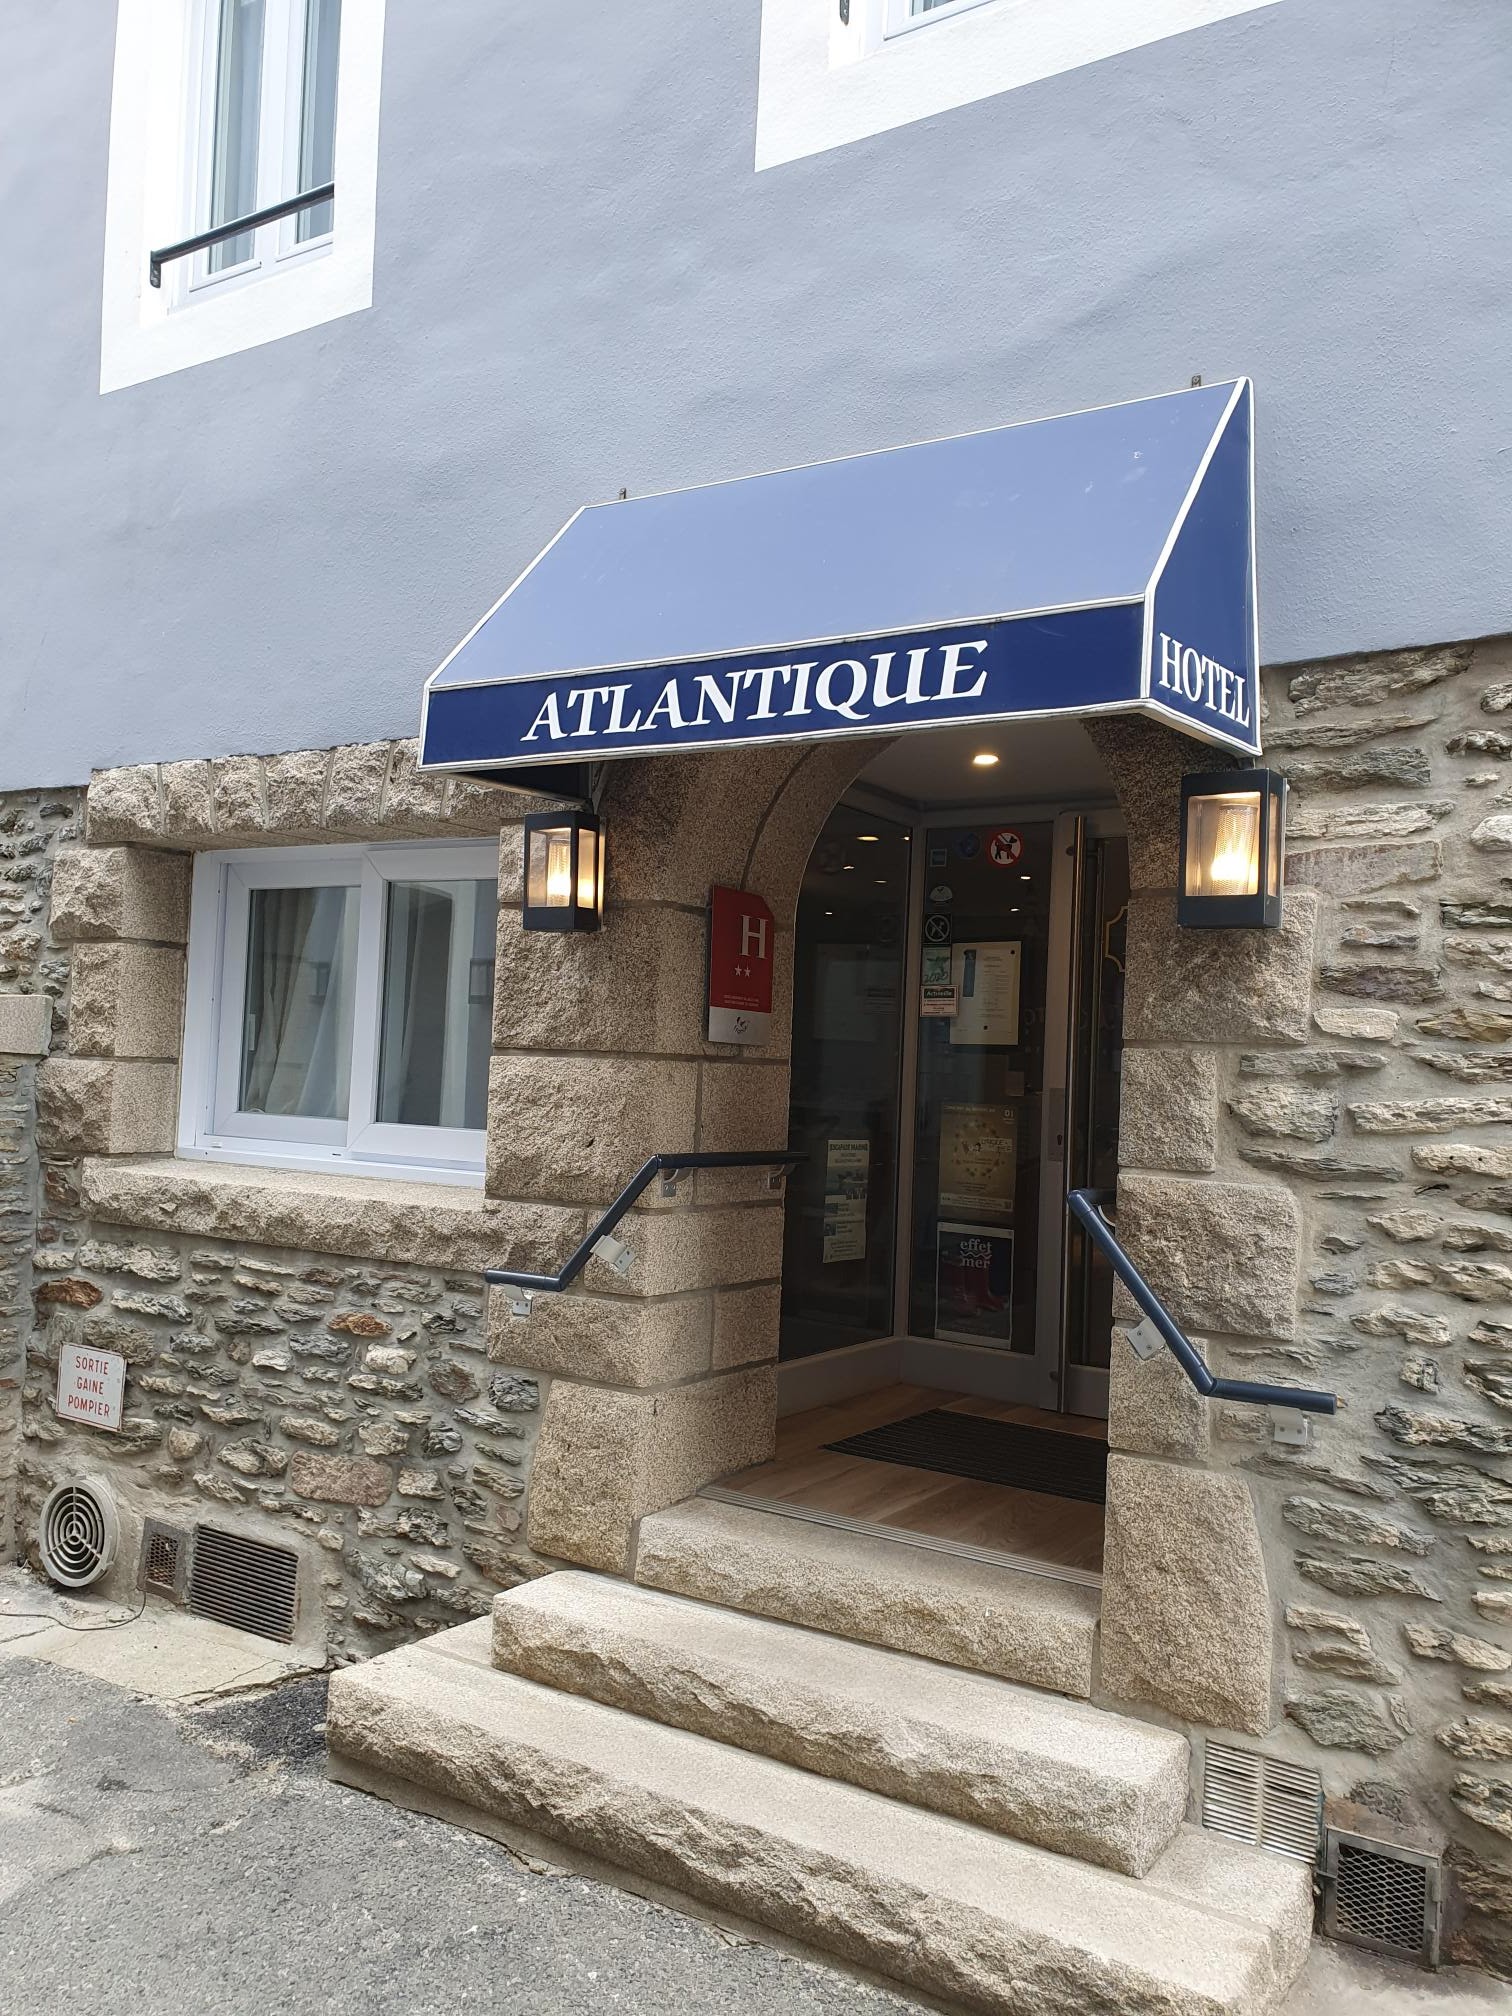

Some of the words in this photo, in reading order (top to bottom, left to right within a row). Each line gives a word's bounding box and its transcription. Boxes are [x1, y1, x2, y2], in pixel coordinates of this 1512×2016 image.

[521, 640, 988, 742] ATLANTIQUE
[1157, 631, 1251, 730] HOTEL
[739, 914, 769, 959] H
[959, 1238, 992, 1255] effet
[960, 1256, 991, 1269] mer
[75, 1355, 109, 1375] SORTIE
[76, 1376, 104, 1395] GAINE
[67, 1394, 110, 1417] POMPIER
